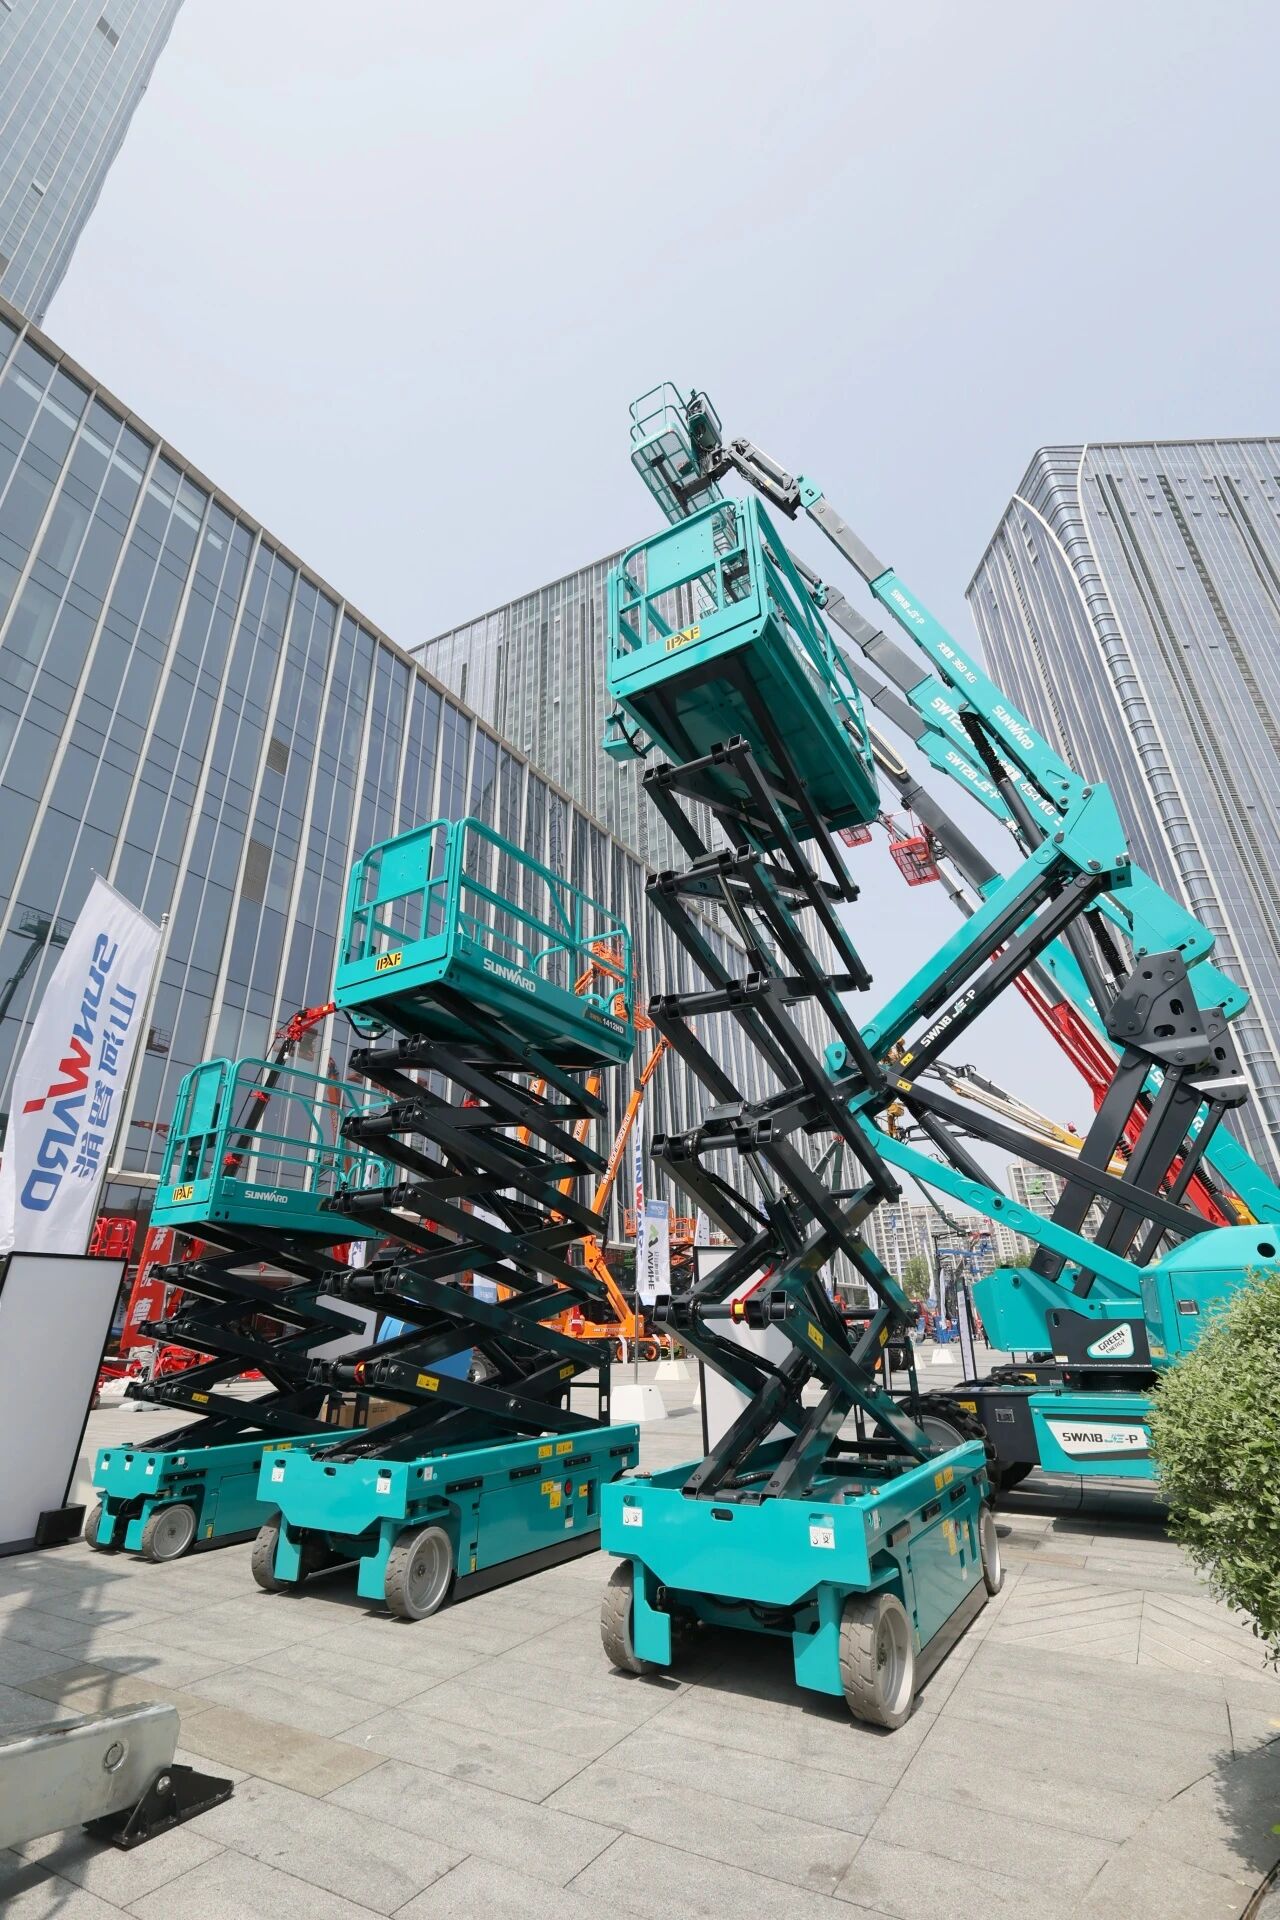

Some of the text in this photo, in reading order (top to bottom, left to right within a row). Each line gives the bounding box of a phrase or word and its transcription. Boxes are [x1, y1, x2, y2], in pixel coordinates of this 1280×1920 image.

[667, 626, 699, 651] IPAF
[952, 657, 967, 673] 360
[965, 671, 977, 684] KG
[992, 704, 1034, 750] SUNWARD
[1020, 781, 1041, 801] 454
[1039, 801, 1056, 816] KG
[376, 953, 401, 971] IPAF
[483, 957, 536, 993] SUNWARD
[173, 1184, 193, 1200] IPAF
[244, 1190, 288, 1203] SUNWARD
[1098, 1330, 1125, 1351] GREEN
[1105, 1339, 1126, 1354] ENERGY
